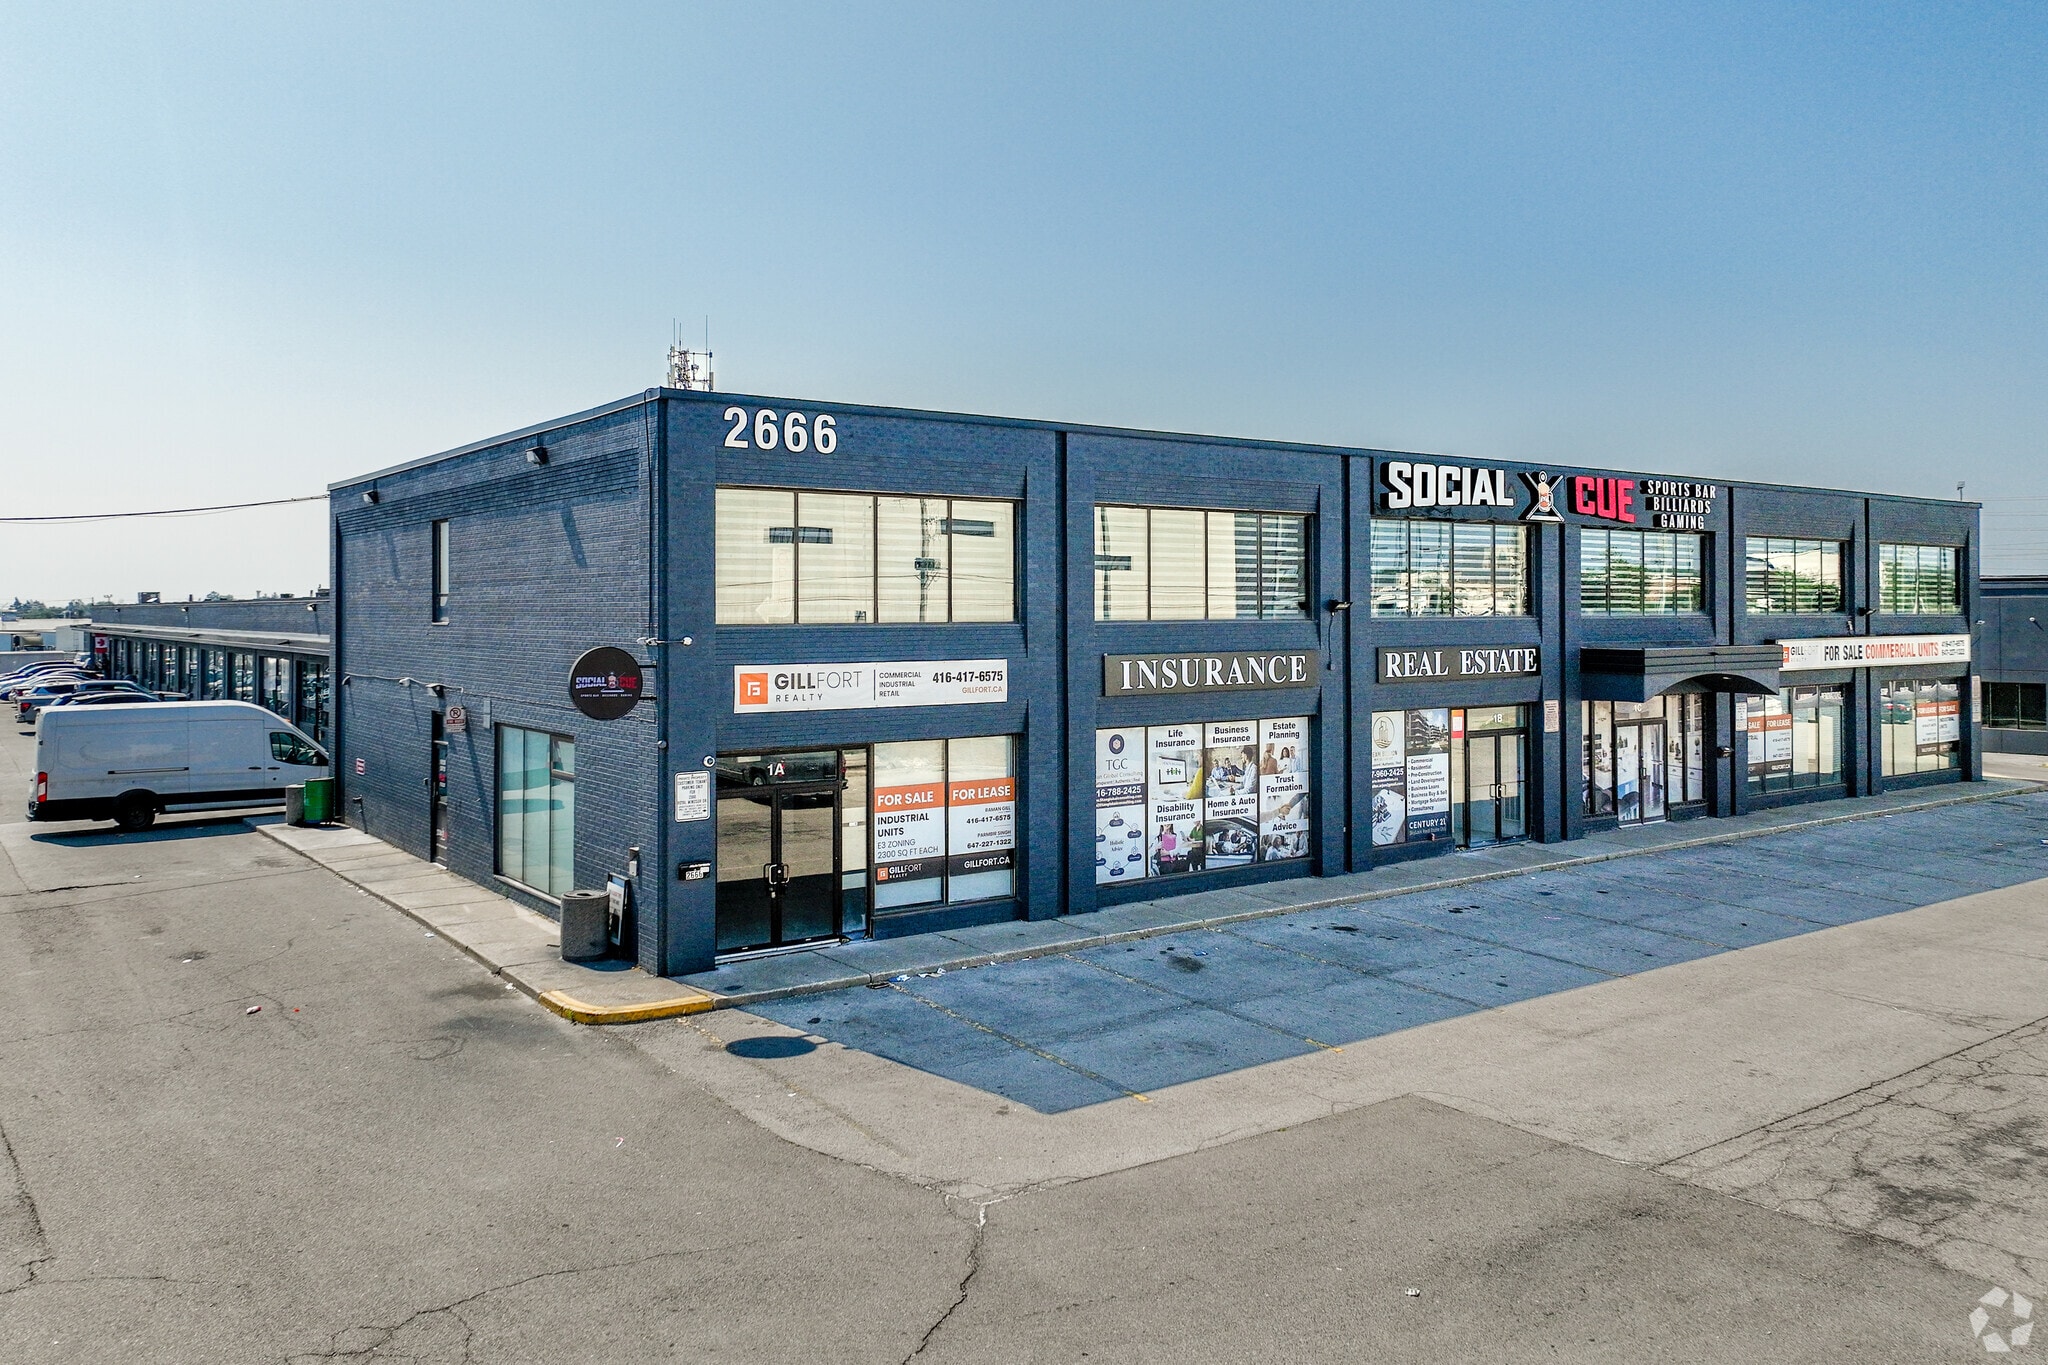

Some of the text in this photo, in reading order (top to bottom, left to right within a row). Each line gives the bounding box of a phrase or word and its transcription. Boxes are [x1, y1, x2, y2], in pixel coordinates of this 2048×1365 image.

[723, 405, 838, 455] 2666
[1388, 461, 1514, 509] SOCIAL
[1647, 479, 1716, 499] SPORTS BAR
[1575, 476, 1636, 523] CUE
[1653, 496, 1711, 514] BILLIARDS
[1661, 513, 1705, 530] GAMING
[1824, 641, 1939, 661] FOR SALE COMMERCIAL UNITS
[1384, 648, 1538, 678] REAL ESTATE
[879, 671, 922, 679] COMMERCIAL
[932, 670, 1003, 683] 416-417-6575
[1120, 655, 1308, 691] INSURANCE
[575, 676, 607, 689] SOCIAL
[619, 675, 638, 689] CUE
[774, 670, 862, 690] GILLFORT
[879, 680, 915, 688] INDUSTRIAL
[962, 686, 1003, 694] GILLFORT.CA
[775, 693, 823, 703] REALTY
[1493, 713, 1503, 723] 1B
[1766, 718, 1791, 728] FOR LEASE
[1214, 726, 1249, 735] Business
[1272, 722, 1296, 730] Estate
[1748, 721, 1760, 729] SALE
[1168, 729, 1183, 738] Life
[1268, 730, 1300, 740] Planning
[1155, 739, 1196, 748] Insurance
[1212, 735, 1251, 744] Insurance
[767, 762, 785, 776] 1A
[1105, 758, 1128, 770] TGC
[1275, 775, 1294, 783] Trust
[952, 785, 1011, 801] FOR LEASE
[1266, 784, 1303, 793] Formation
[877, 790, 934, 807] FOR SALE
[1207, 797, 1256, 809] Home & Auto
[1157, 802, 1195, 813] Disability
[1212, 807, 1249, 817] Insurance
[877, 812, 930, 825] INDUSTRIAL
[966, 814, 1011, 824] 416-417-6575
[1155, 812, 1196, 823] Insurance
[1272, 822, 1297, 832] Advice
[1409, 818, 1439, 829] CENTURY
[877, 827, 904, 837] UNITS
[877, 838, 916, 850] E3 ZONING
[967, 839, 1012, 849] 647-227-1322
[877, 845, 939, 859] 2300 SQ FT EACH
[964, 856, 1011, 869] GILLFORT.CA
[888, 863, 922, 874] GILLFORT
